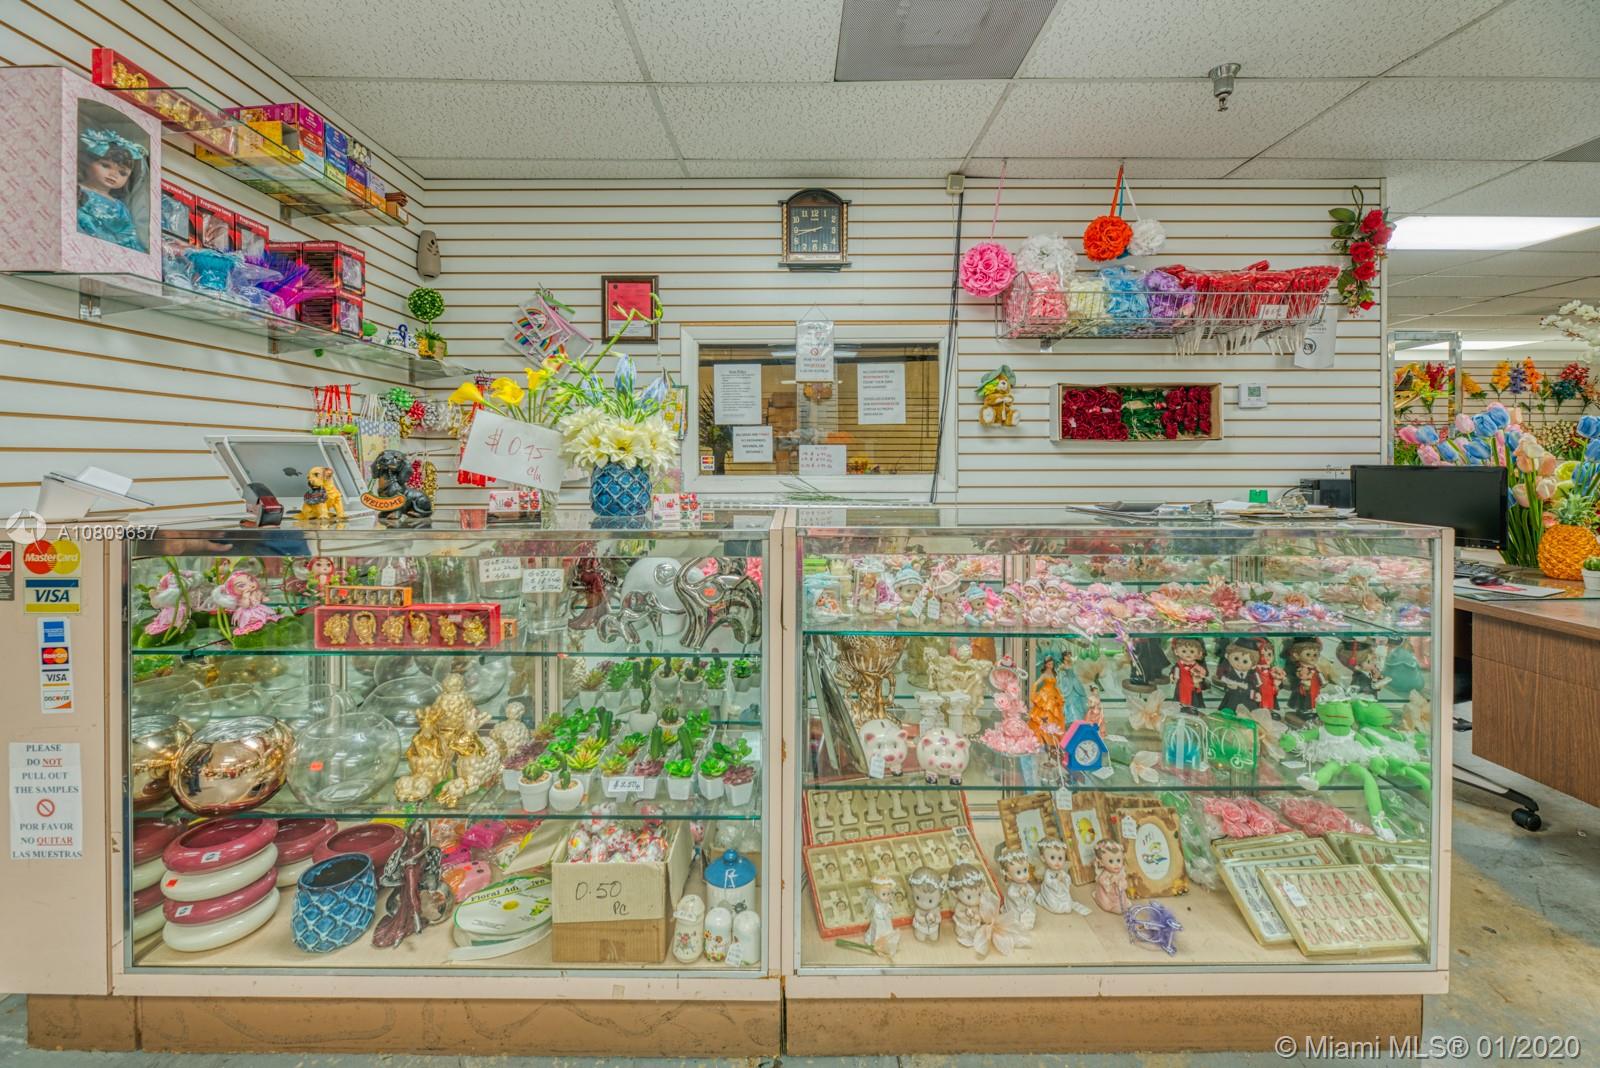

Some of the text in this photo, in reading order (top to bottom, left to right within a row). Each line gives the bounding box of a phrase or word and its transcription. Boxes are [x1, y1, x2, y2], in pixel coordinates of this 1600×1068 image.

[362, 494, 405, 510] WELCOME
[24, 552, 79, 563] MasterCard
[35, 589, 70, 603] VISA
[46, 673, 67, 682] VISA
[26, 743, 62, 752] PLEASE
[26, 758, 62, 767] DO NOT
[21, 771, 68, 780] PULL OUT
[15, 785, 80, 794] THE SAMPLES
[20, 822, 74, 831] POR FAVOR
[20, 836, 74, 846] NO QUITAR
[12, 849, 83, 859] LAS MUESTRAS
[575, 880, 623, 901] 0.50
[470, 890, 501, 902] Floral
